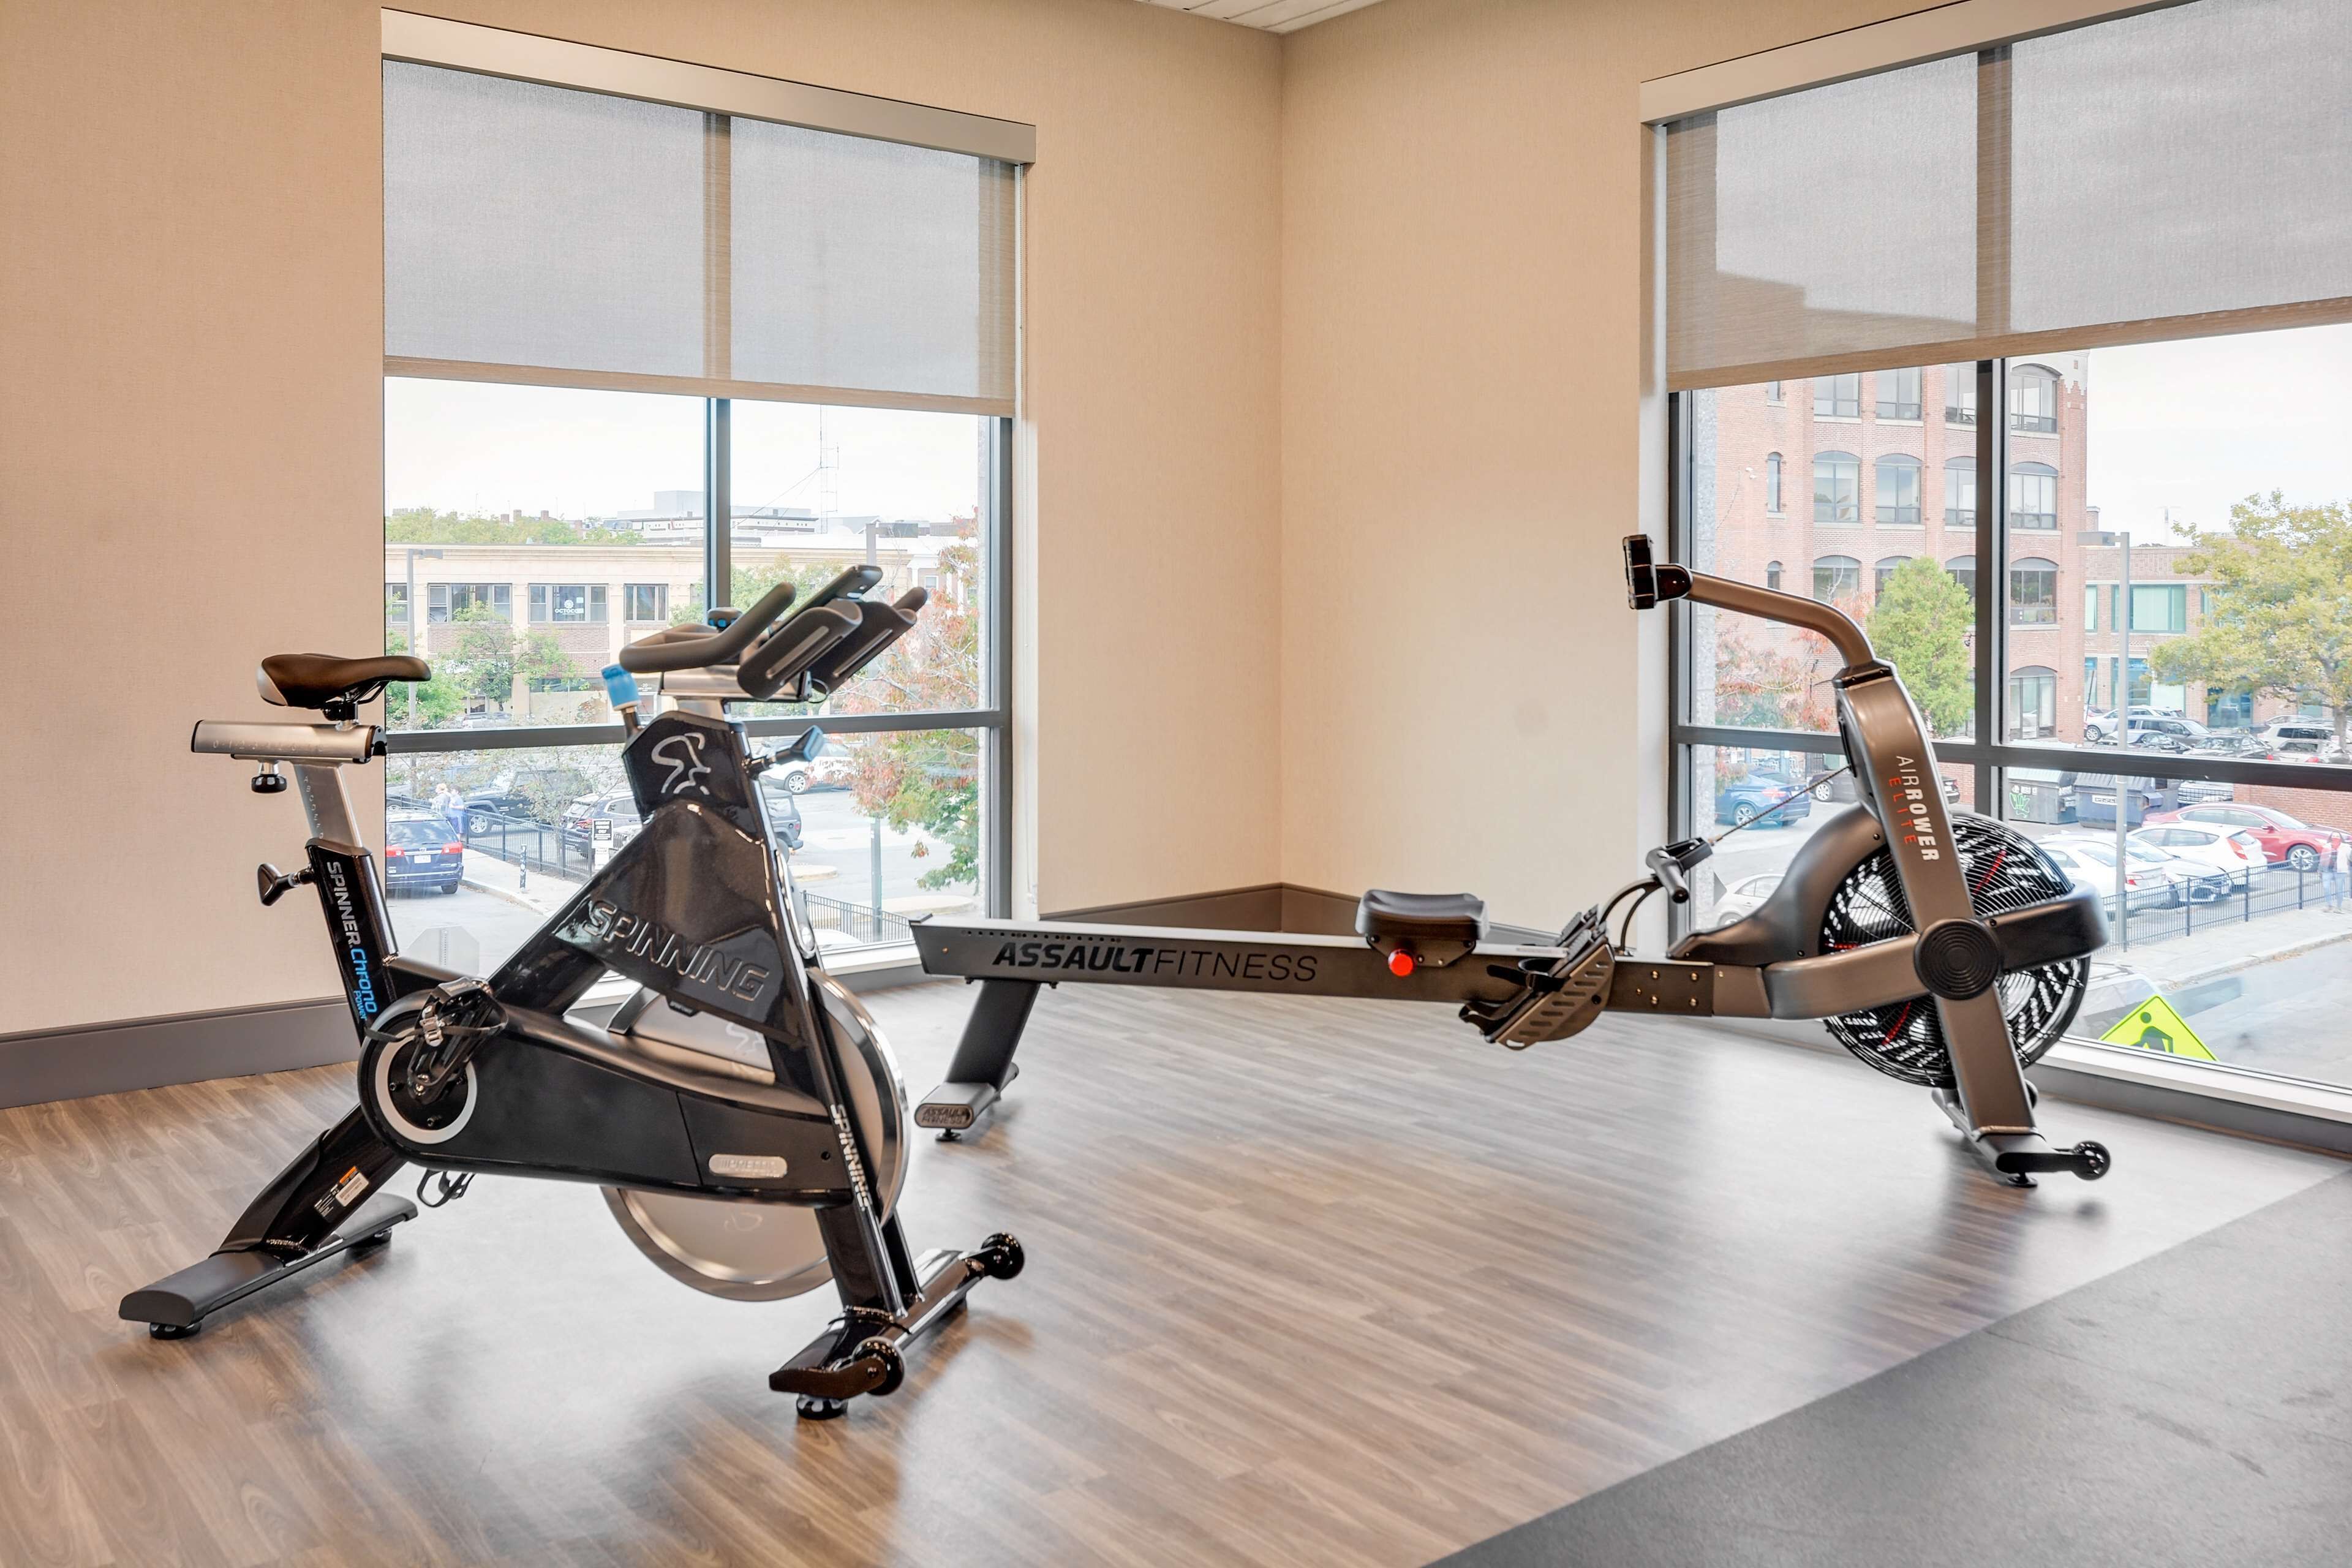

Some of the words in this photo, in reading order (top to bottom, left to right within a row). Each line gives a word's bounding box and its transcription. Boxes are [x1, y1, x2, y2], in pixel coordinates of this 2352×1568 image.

[1889, 777, 1917, 844] ELITE
[350, 948, 377, 1014] Chrono
[582, 900, 769, 1001] SPINNING
[353, 990, 368, 1020] Power
